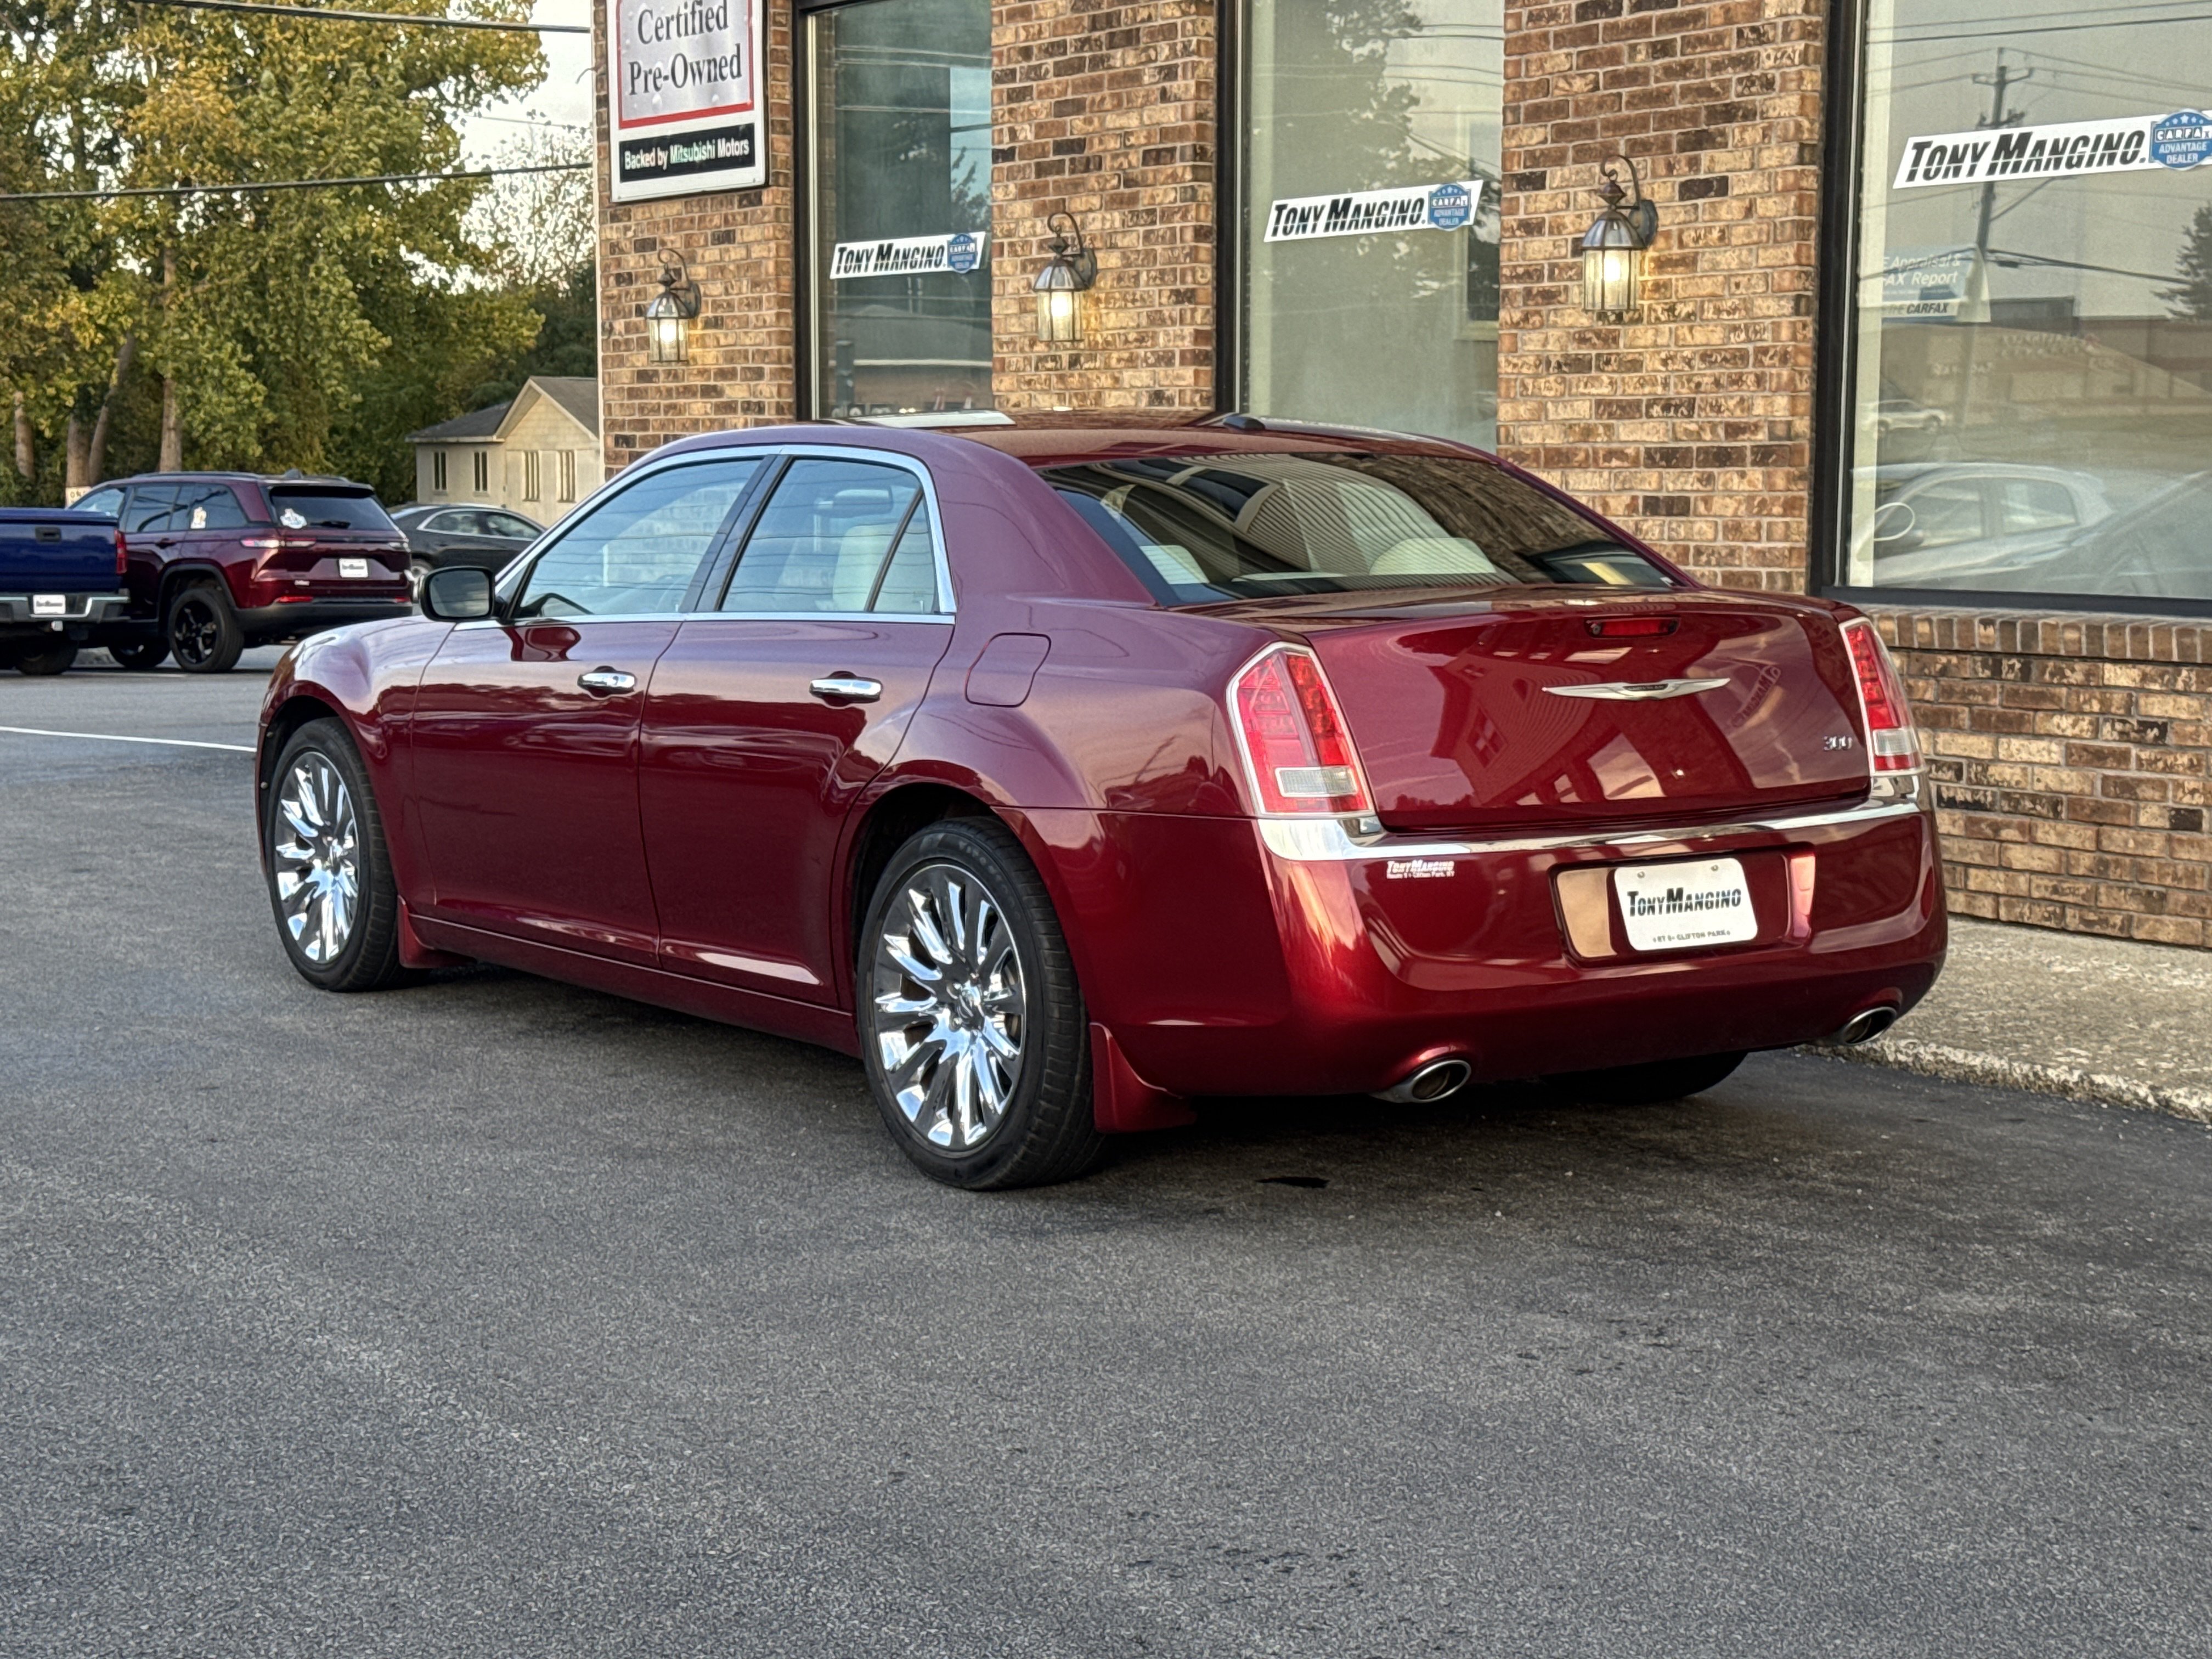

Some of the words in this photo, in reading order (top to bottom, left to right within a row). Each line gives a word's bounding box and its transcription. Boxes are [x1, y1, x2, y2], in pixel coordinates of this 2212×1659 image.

[637, 0, 729, 44] Certified
[628, 43, 742, 95] Pre-Owned
[2157, 127, 2211, 140] CARFAX
[624, 147, 656, 170] Backed
[657, 146, 668, 171] by
[670, 139, 715, 164] Mitsubishi
[717, 138, 749, 158] Motors
[2159, 142, 2207, 154] ADVANTAGE
[2166, 153, 2198, 164] DEALER
[1912, 271, 1958, 286] Report
[1906, 303, 1949, 314] CARFAX
[1676, 932, 1706, 940] CLIFTON
